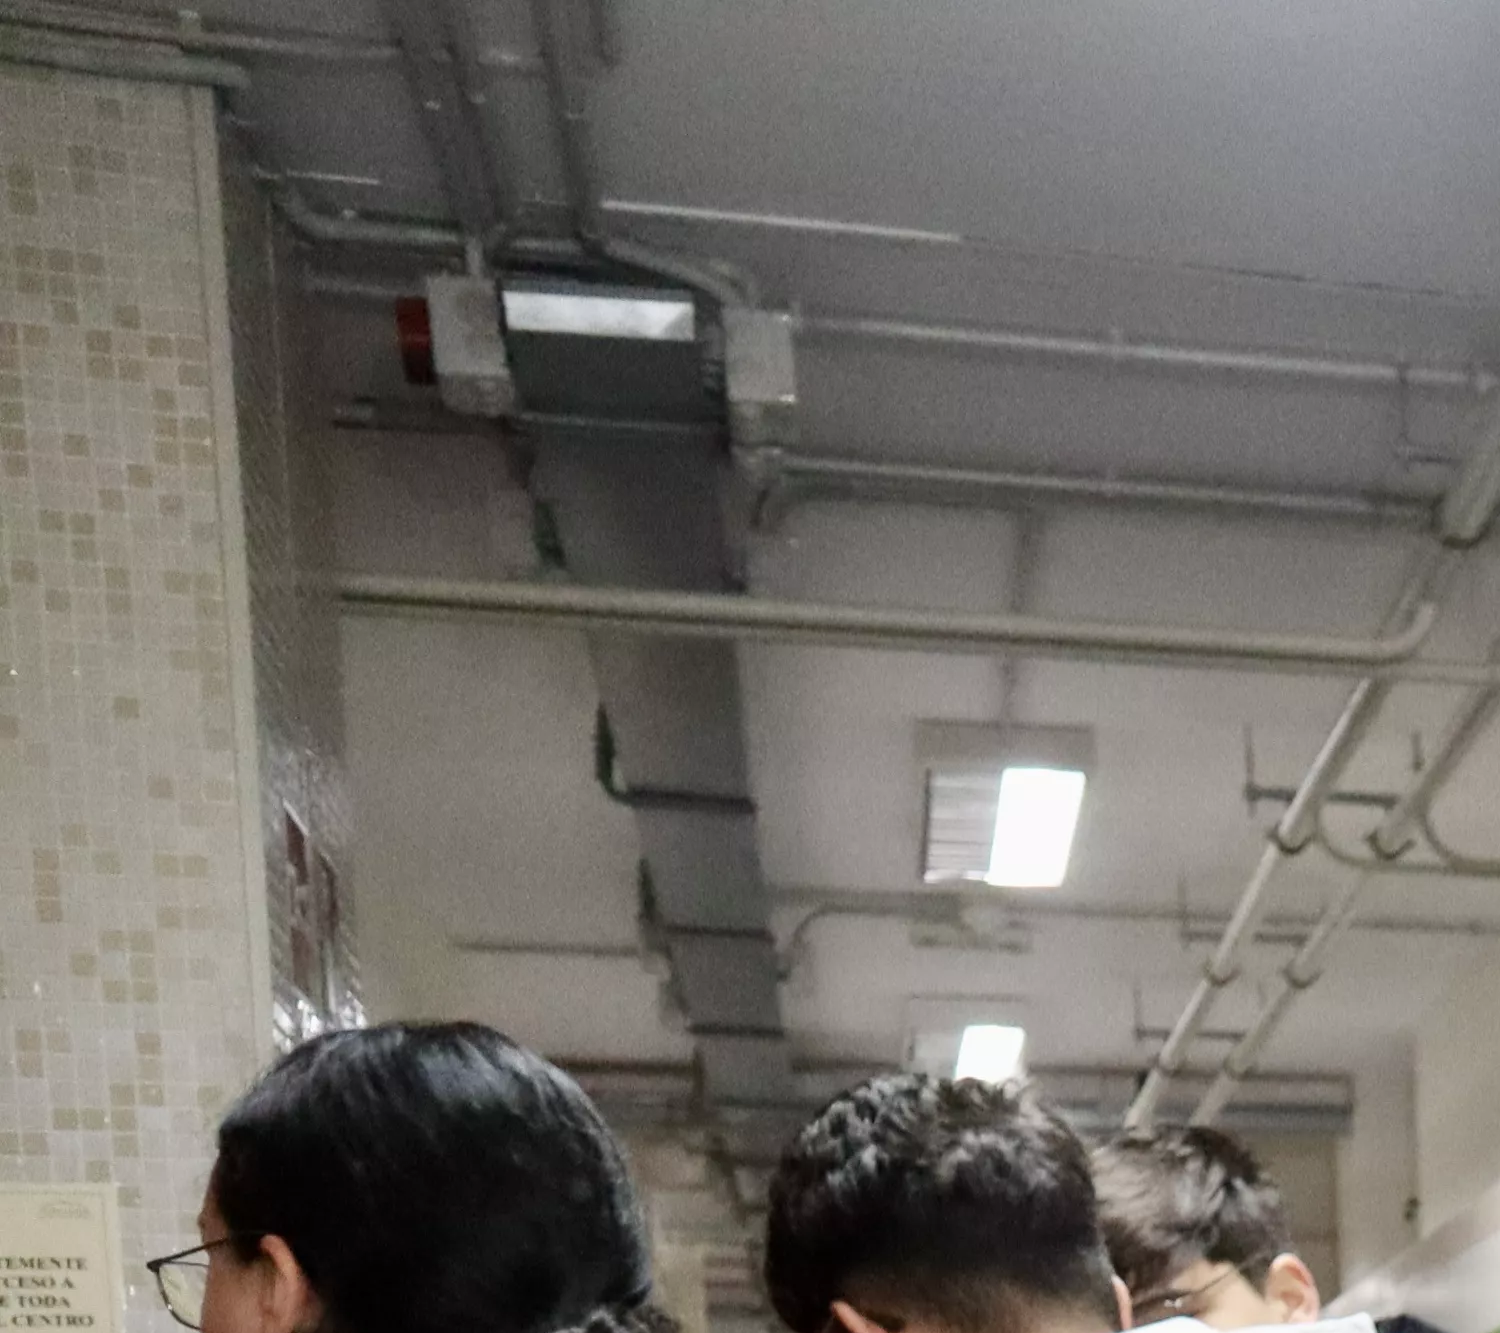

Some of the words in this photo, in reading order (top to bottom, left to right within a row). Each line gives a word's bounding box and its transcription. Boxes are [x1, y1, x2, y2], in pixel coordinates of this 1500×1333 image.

[0, 1257, 88, 1271] EMENTE
[0, 1276, 56, 1288] CESO
[11, 1314, 95, 1328] CENTRO
